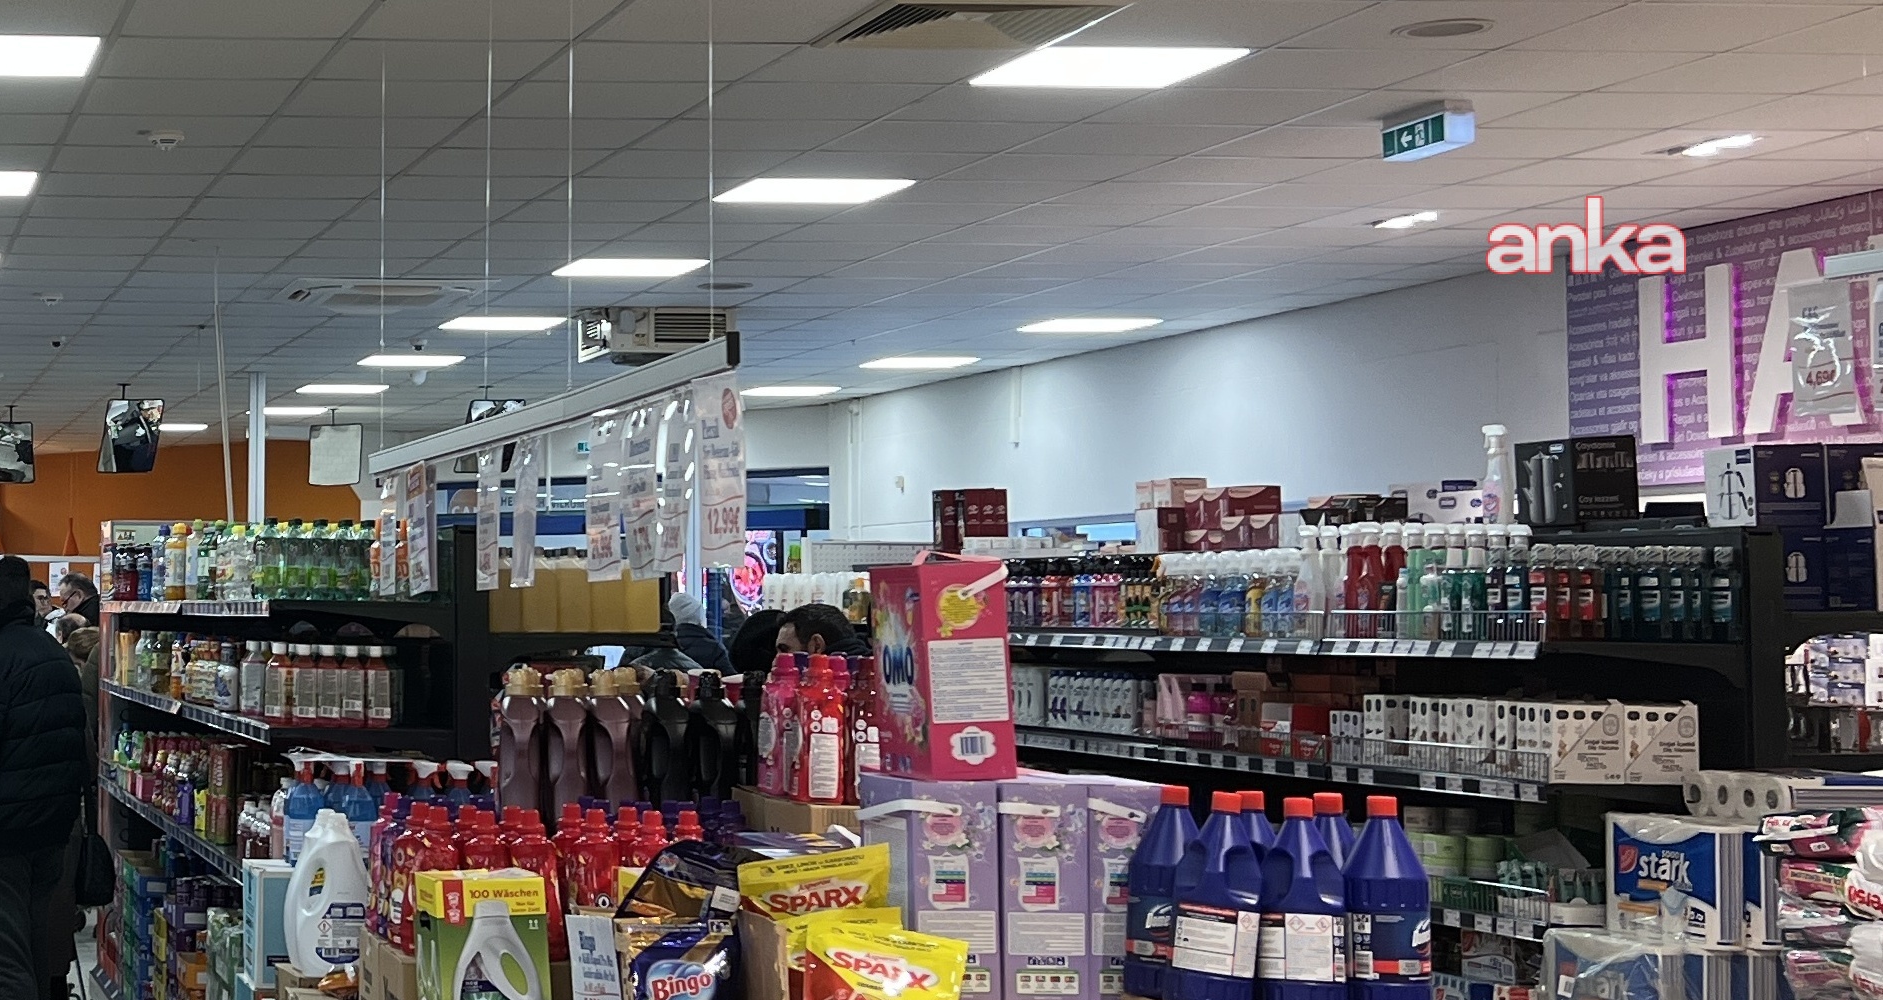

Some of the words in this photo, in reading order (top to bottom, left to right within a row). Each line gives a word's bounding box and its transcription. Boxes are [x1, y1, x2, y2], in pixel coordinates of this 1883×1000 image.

[883, 647, 914, 687] OMO
[1638, 853, 1690, 883] stark
[469, 889, 489, 899] 100
[493, 888, 539, 898] Wäschen
[769, 885, 863, 913] SPARX
